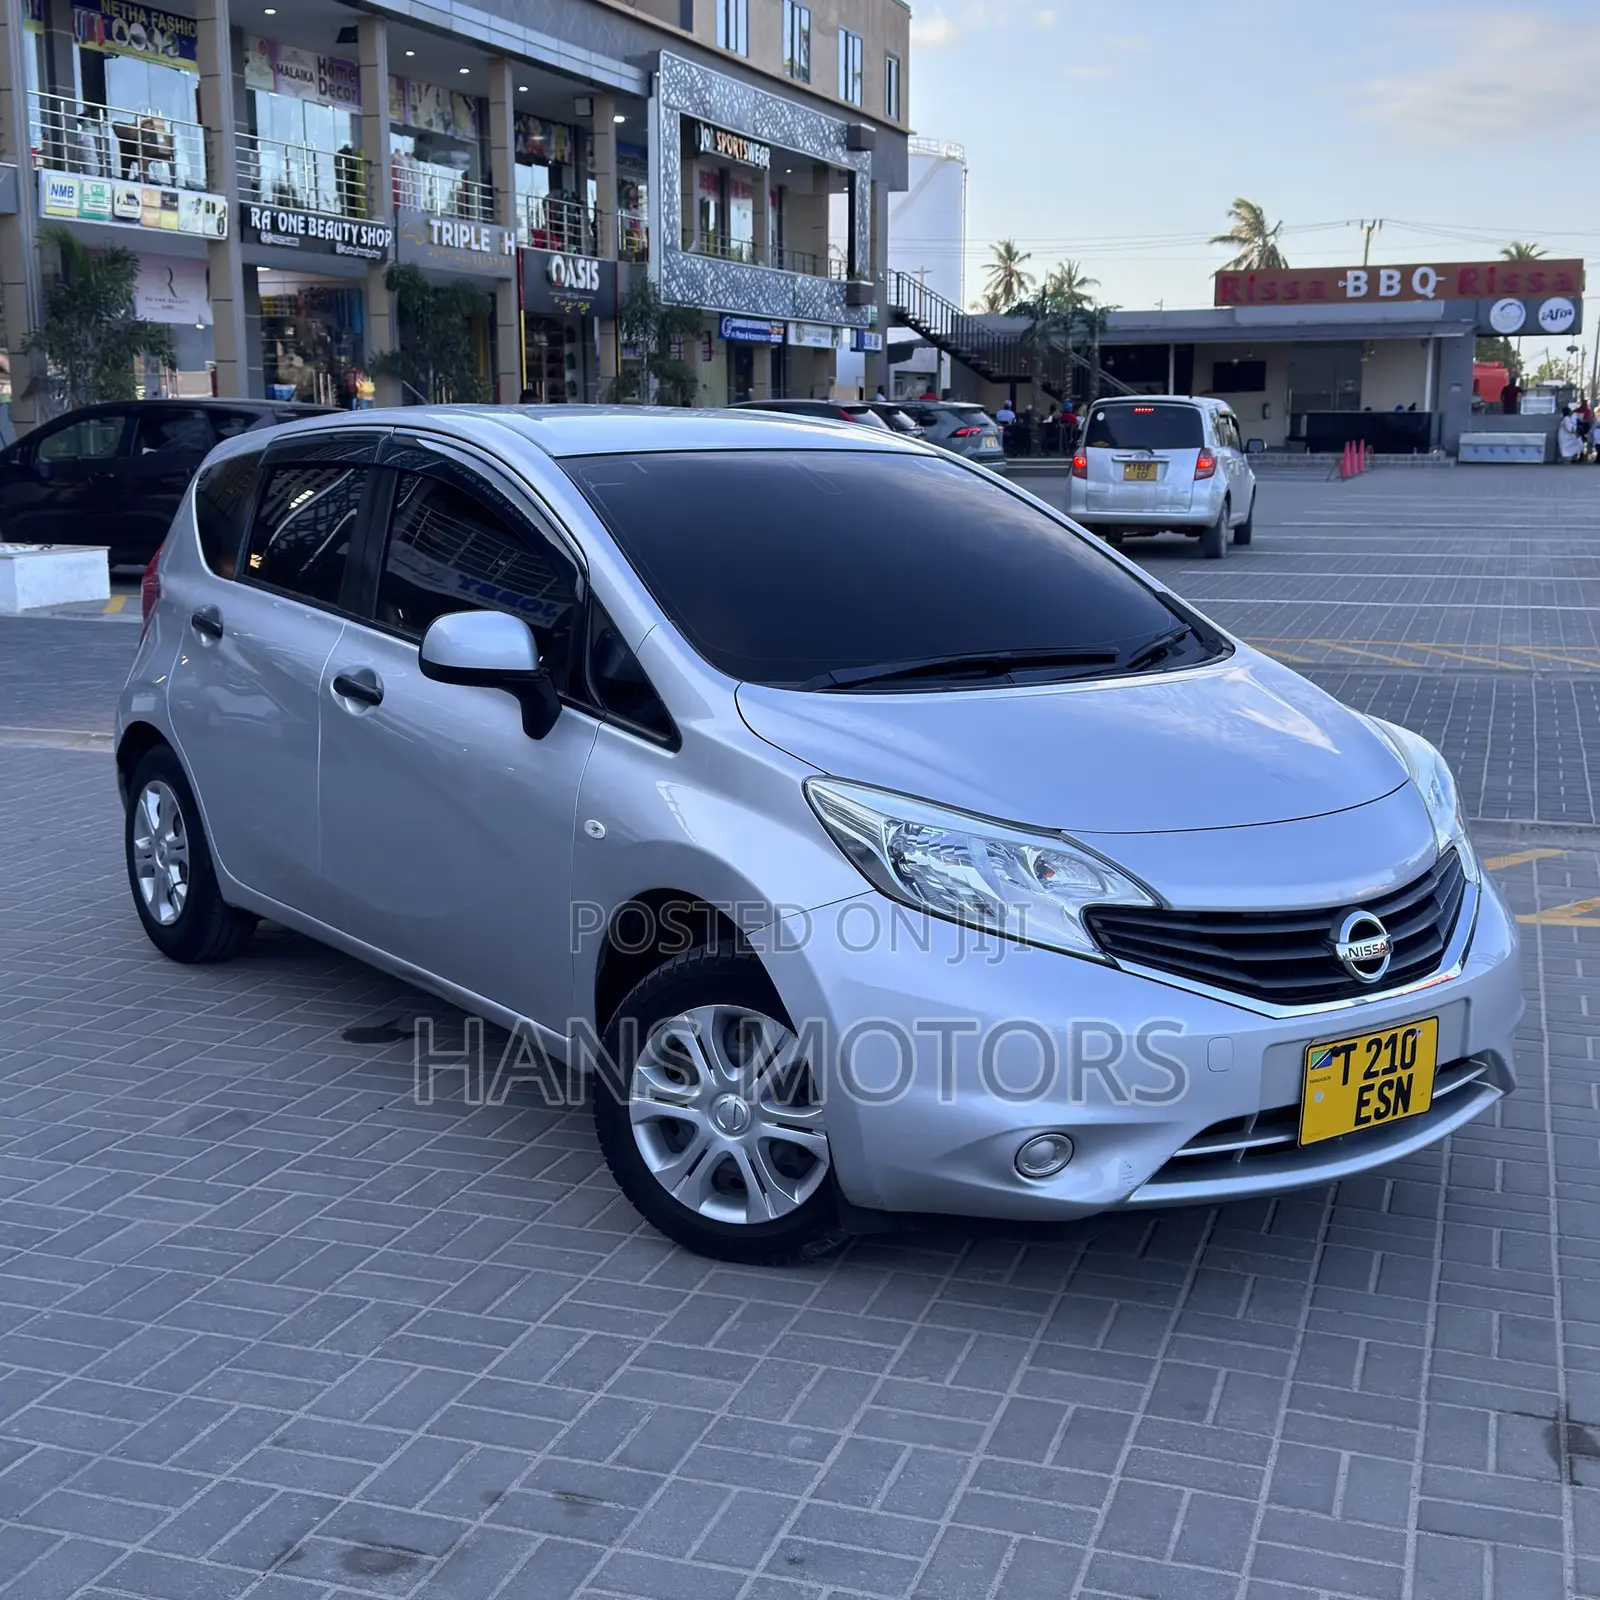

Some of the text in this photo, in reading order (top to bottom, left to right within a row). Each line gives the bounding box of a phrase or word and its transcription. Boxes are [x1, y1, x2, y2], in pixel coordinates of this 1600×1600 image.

[276, 63, 315, 83] MALAIKA
[317, 55, 356, 82] Home
[318, 76, 356, 102] Decor
[50, 183, 75, 198] NMB
[307, 216, 358, 245] BEAUTY
[359, 225, 393, 248] SHOP
[428, 218, 515, 256] TRIPLE H
[551, 254, 600, 291] OASIS
[1219, 264, 1574, 303] Rissa BBQ Rissa
[1332, 1027, 1418, 1087] T 210
[1354, 1072, 1414, 1127] ESN
